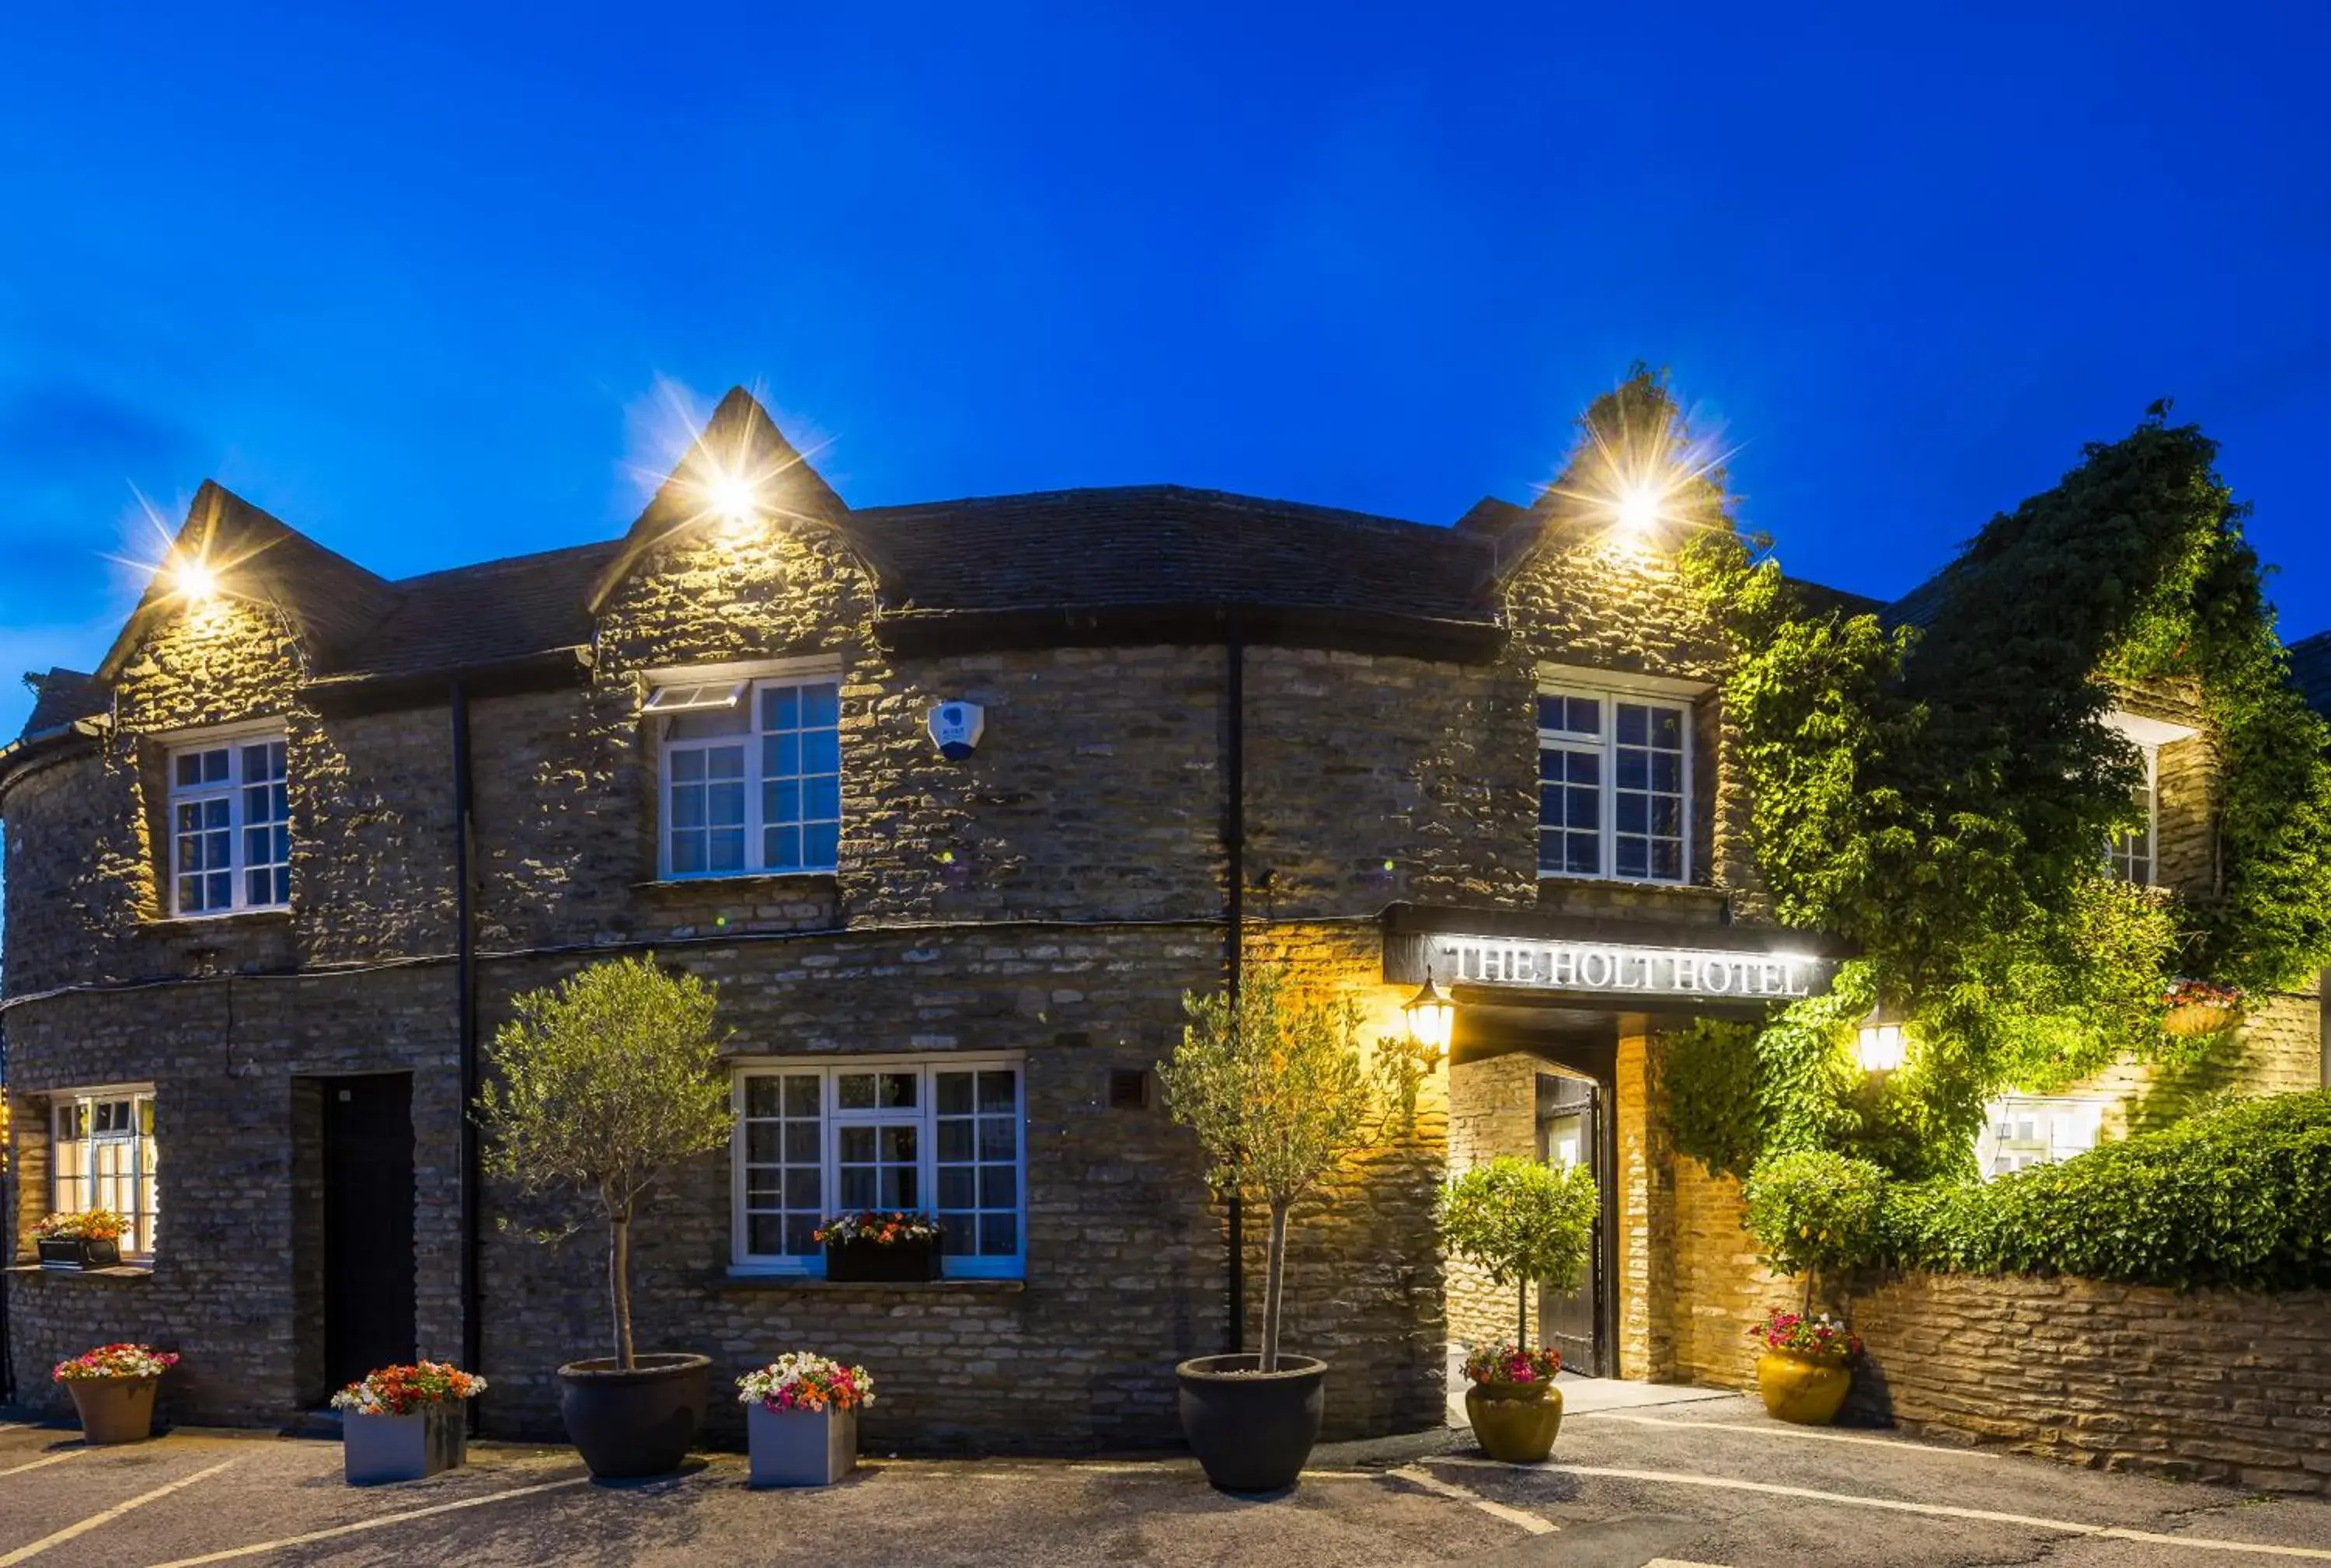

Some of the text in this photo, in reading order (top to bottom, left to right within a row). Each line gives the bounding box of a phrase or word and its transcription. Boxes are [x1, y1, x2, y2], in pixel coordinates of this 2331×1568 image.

[1445, 941, 1809, 996] THE HOLT HOTEL
